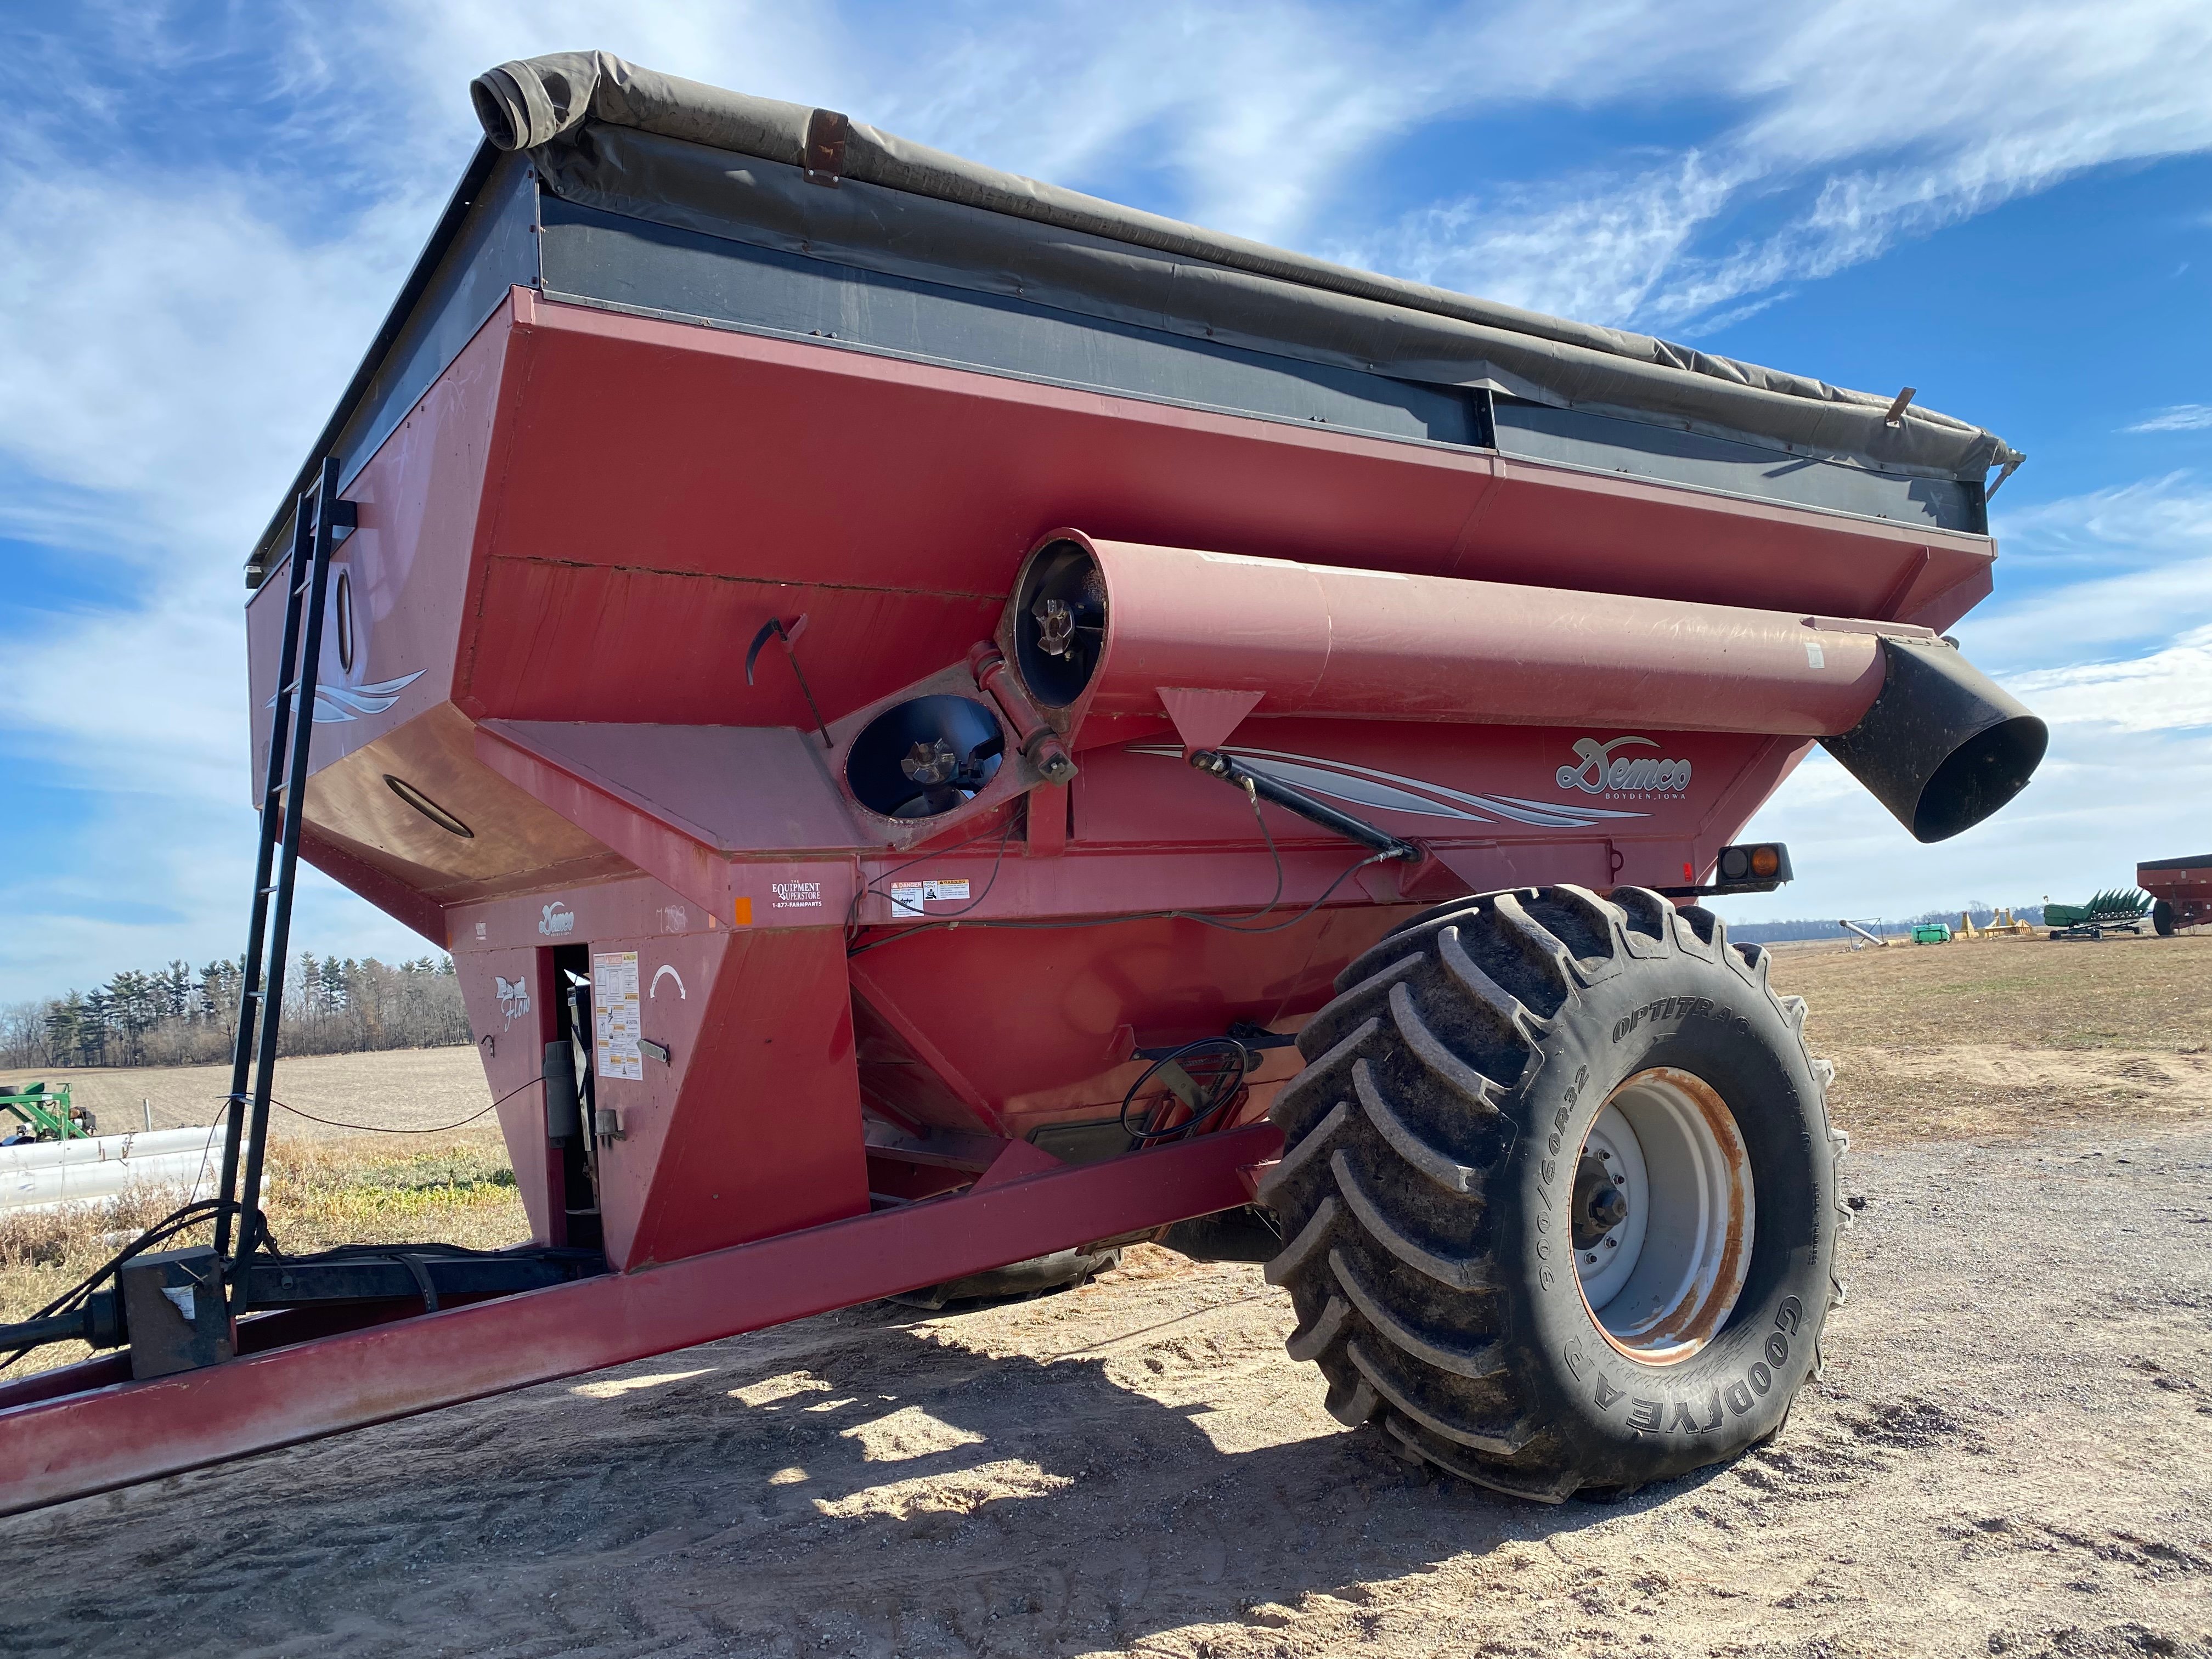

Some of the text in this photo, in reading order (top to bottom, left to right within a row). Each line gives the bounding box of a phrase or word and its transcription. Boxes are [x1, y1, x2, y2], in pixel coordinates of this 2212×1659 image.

[1555, 736, 1692, 795] Demco
[772, 882, 820, 896] EQUIPMENT
[781, 891, 821, 900] SUPERSTORE
[538, 901, 574, 935] Demco
[501, 992, 531, 1033] Flow
[1612, 995, 1752, 1044] OPTITRAC
[1535, 1062, 1590, 1292] 900/60R32
[1564, 1295, 1804, 1435] GOODYEAR
